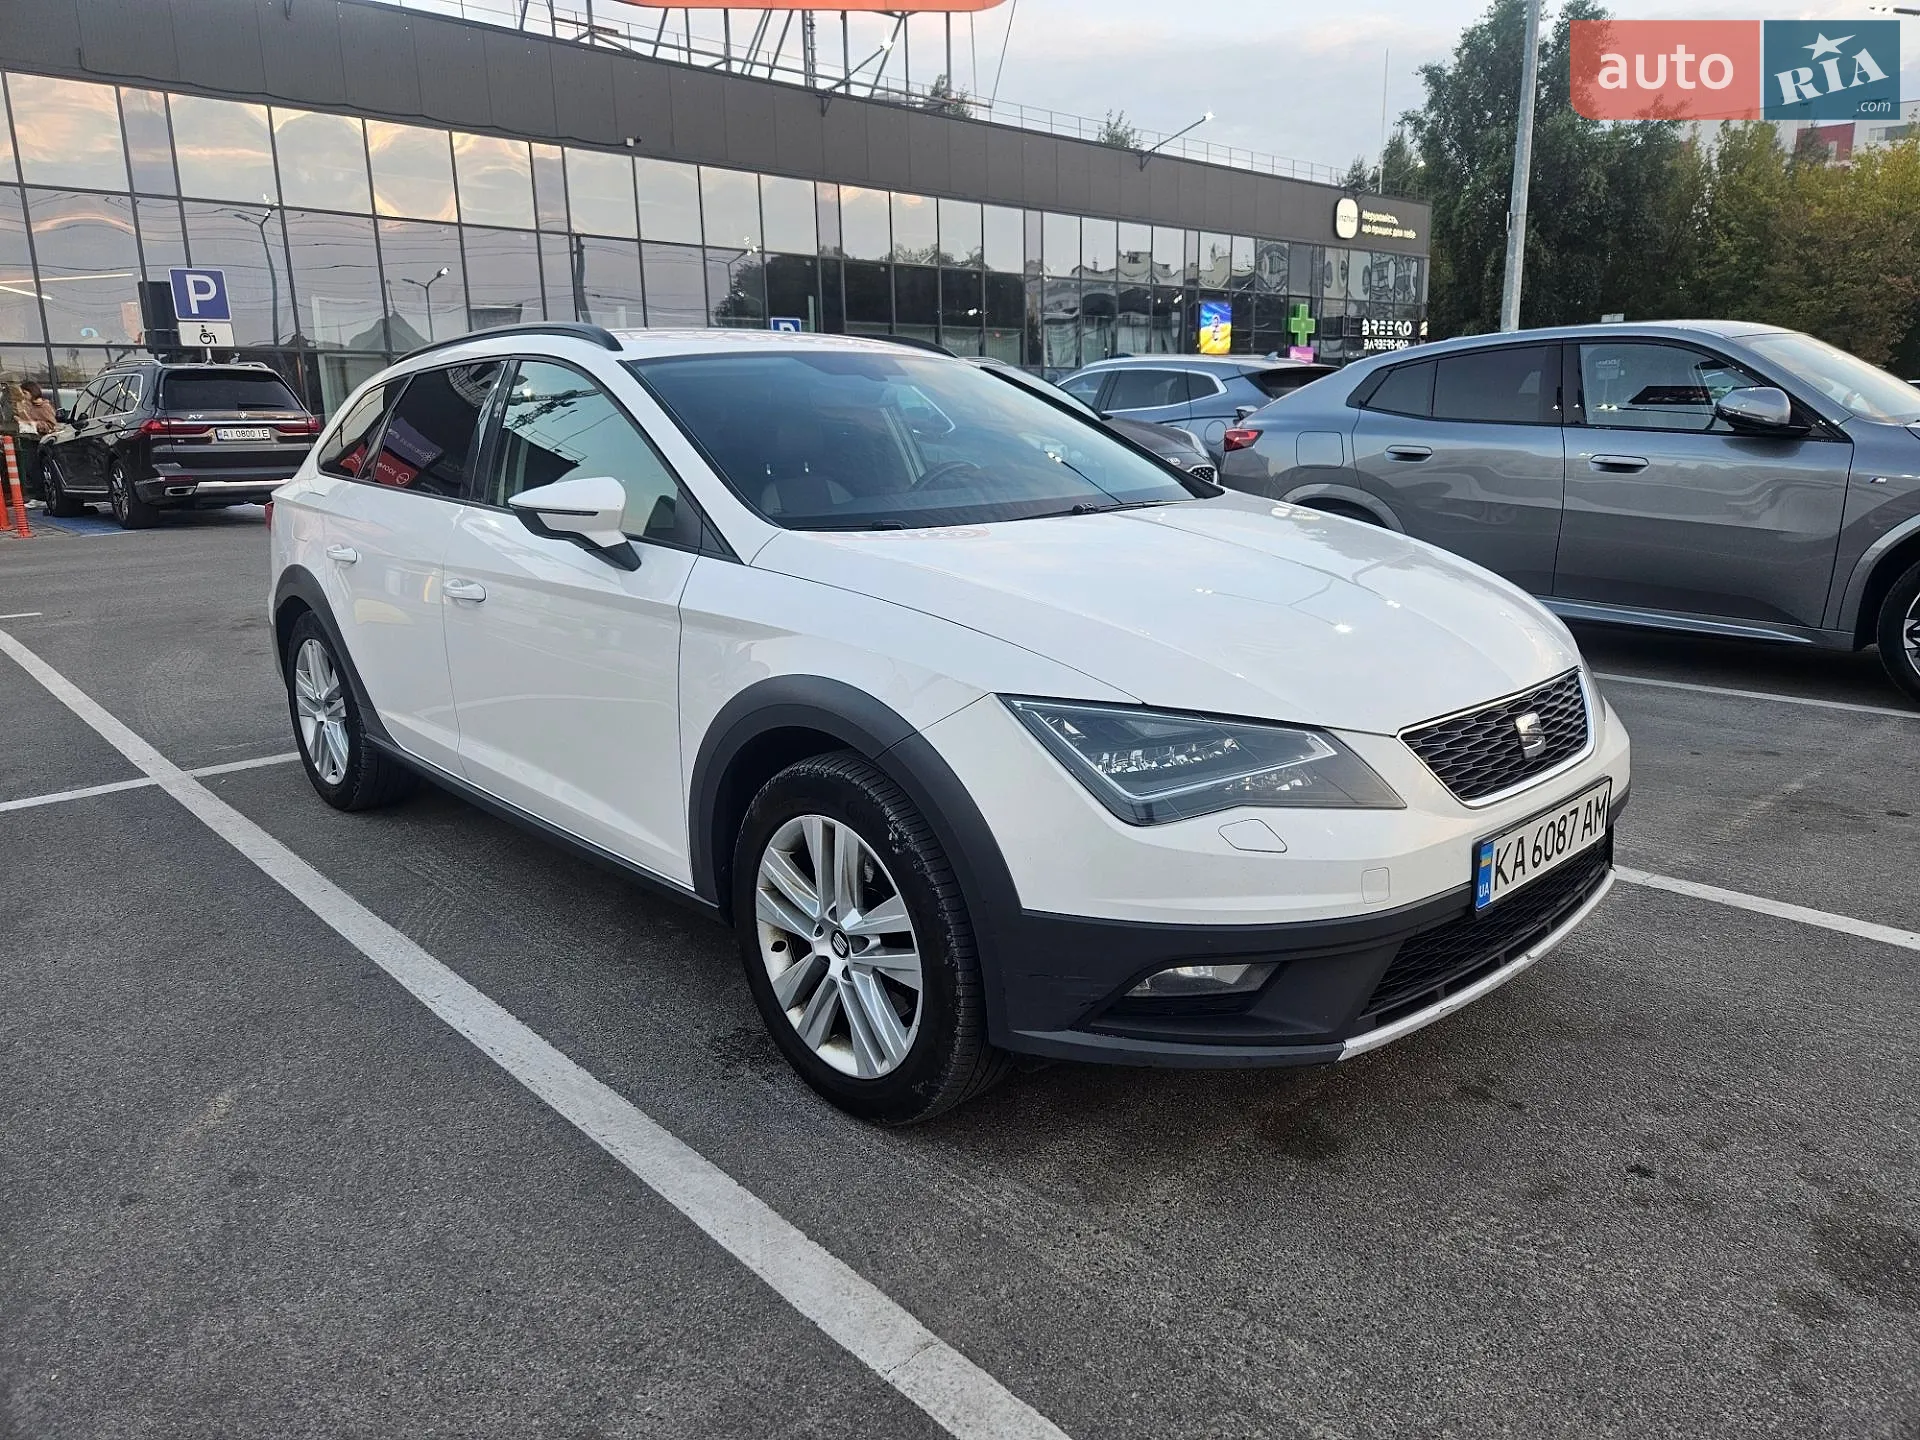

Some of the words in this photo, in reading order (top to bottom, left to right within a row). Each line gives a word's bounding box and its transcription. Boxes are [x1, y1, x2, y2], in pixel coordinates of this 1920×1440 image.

[185, 274, 217, 314] P
[223, 430, 234, 438] AI
[1494, 835, 1526, 891] KA
[1531, 806, 1580, 869] 6087
[1580, 789, 1609, 842] AM
[1478, 881, 1490, 898] UA
